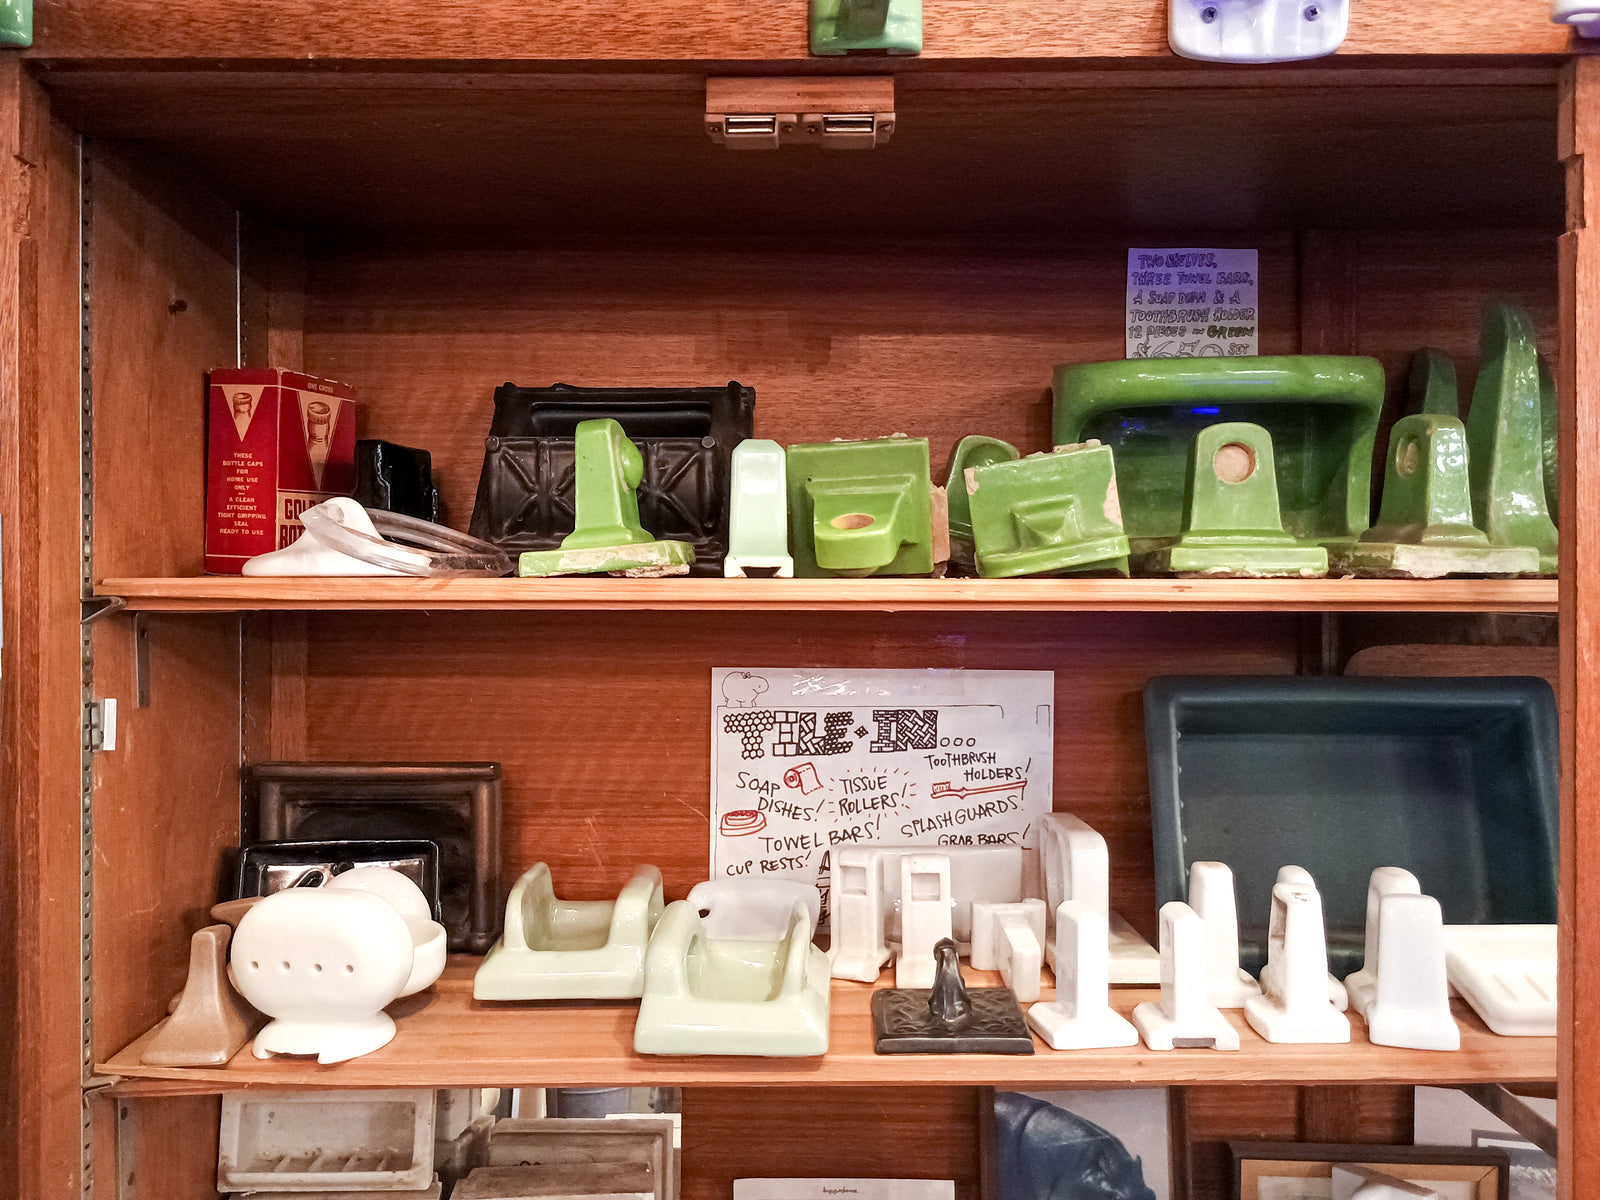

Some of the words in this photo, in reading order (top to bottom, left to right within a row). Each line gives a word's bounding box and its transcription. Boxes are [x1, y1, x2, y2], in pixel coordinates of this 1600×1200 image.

[1138, 254, 1164, 269] TWO
[1165, 253, 1218, 269] SHELVES,
[1131, 271, 1172, 286] THREE
[1177, 271, 1212, 285] TOWEL
[1215, 271, 1254, 286] BARS,
[1133, 289, 1143, 305] A
[1147, 290, 1175, 305] SOAP
[1177, 291, 1206, 305] DISH
[1213, 289, 1225, 304] &
[1229, 290, 1241, 305] A
[1130, 307, 1210, 324] TOOTHBRUSH
[1212, 306, 1255, 323] HOLDER
[1128, 325, 1143, 339] 12
[1146, 325, 1187, 339] PIECES
[1207, 325, 1255, 339] GREEN
[1227, 342, 1250, 355] SET
[237, 512, 267, 520] GRIPPING
[923, 751, 997, 770] TOOTHBRUSH
[963, 757, 1032, 782] HOLDERS!
[735, 771, 781, 797] SOAP
[840, 775, 888, 795] TISSUE
[757, 795, 826, 823] DISHES!
[838, 783, 908, 817] ROLLERS!
[757, 831, 823, 854] TOWEL
[828, 814, 882, 847] BARS!
[937, 833, 974, 846] GRAB
[726, 861, 754, 877] CUP
[759, 851, 811, 873] RESTS!
